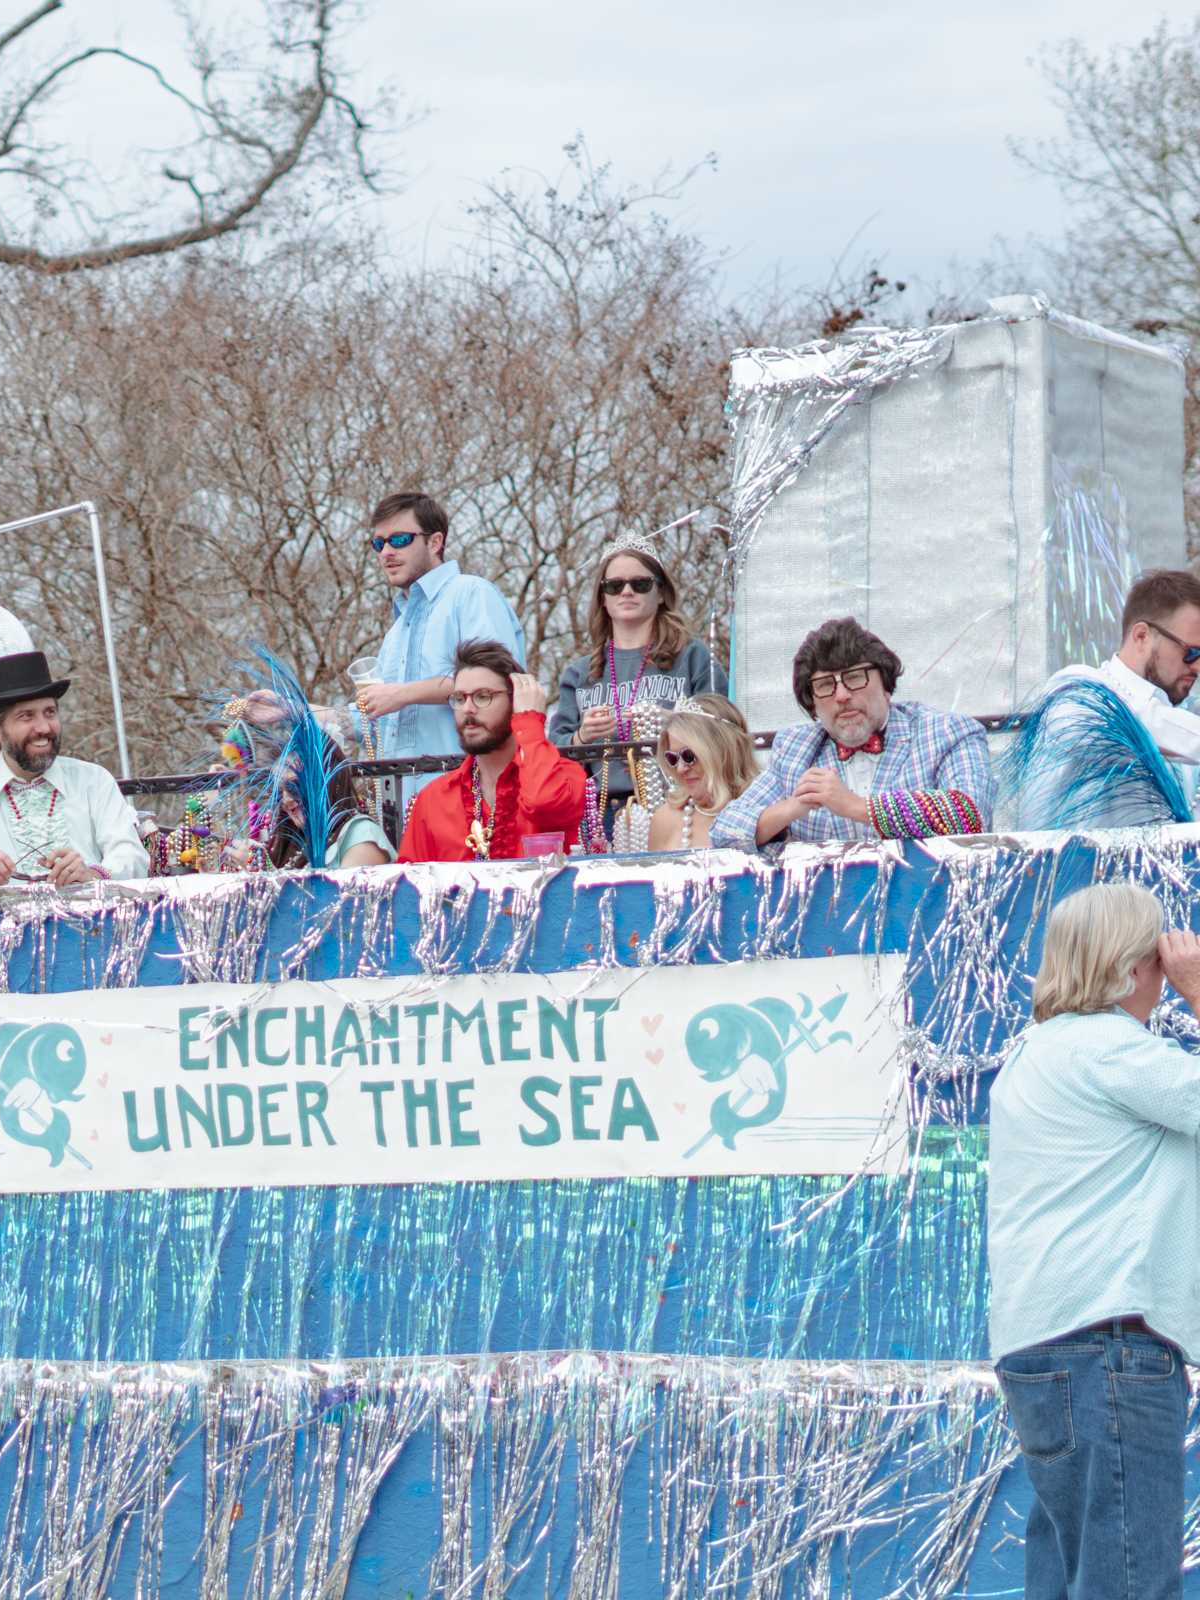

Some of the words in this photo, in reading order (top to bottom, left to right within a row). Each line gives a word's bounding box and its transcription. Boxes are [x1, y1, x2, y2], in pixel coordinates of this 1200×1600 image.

[605, 674, 686, 707] DONION
[179, 996, 620, 1070] ENCHANTMENT
[122, 1080, 337, 1153] UNDER
[360, 1077, 481, 1148] THE
[518, 1075, 659, 1148] SEA
